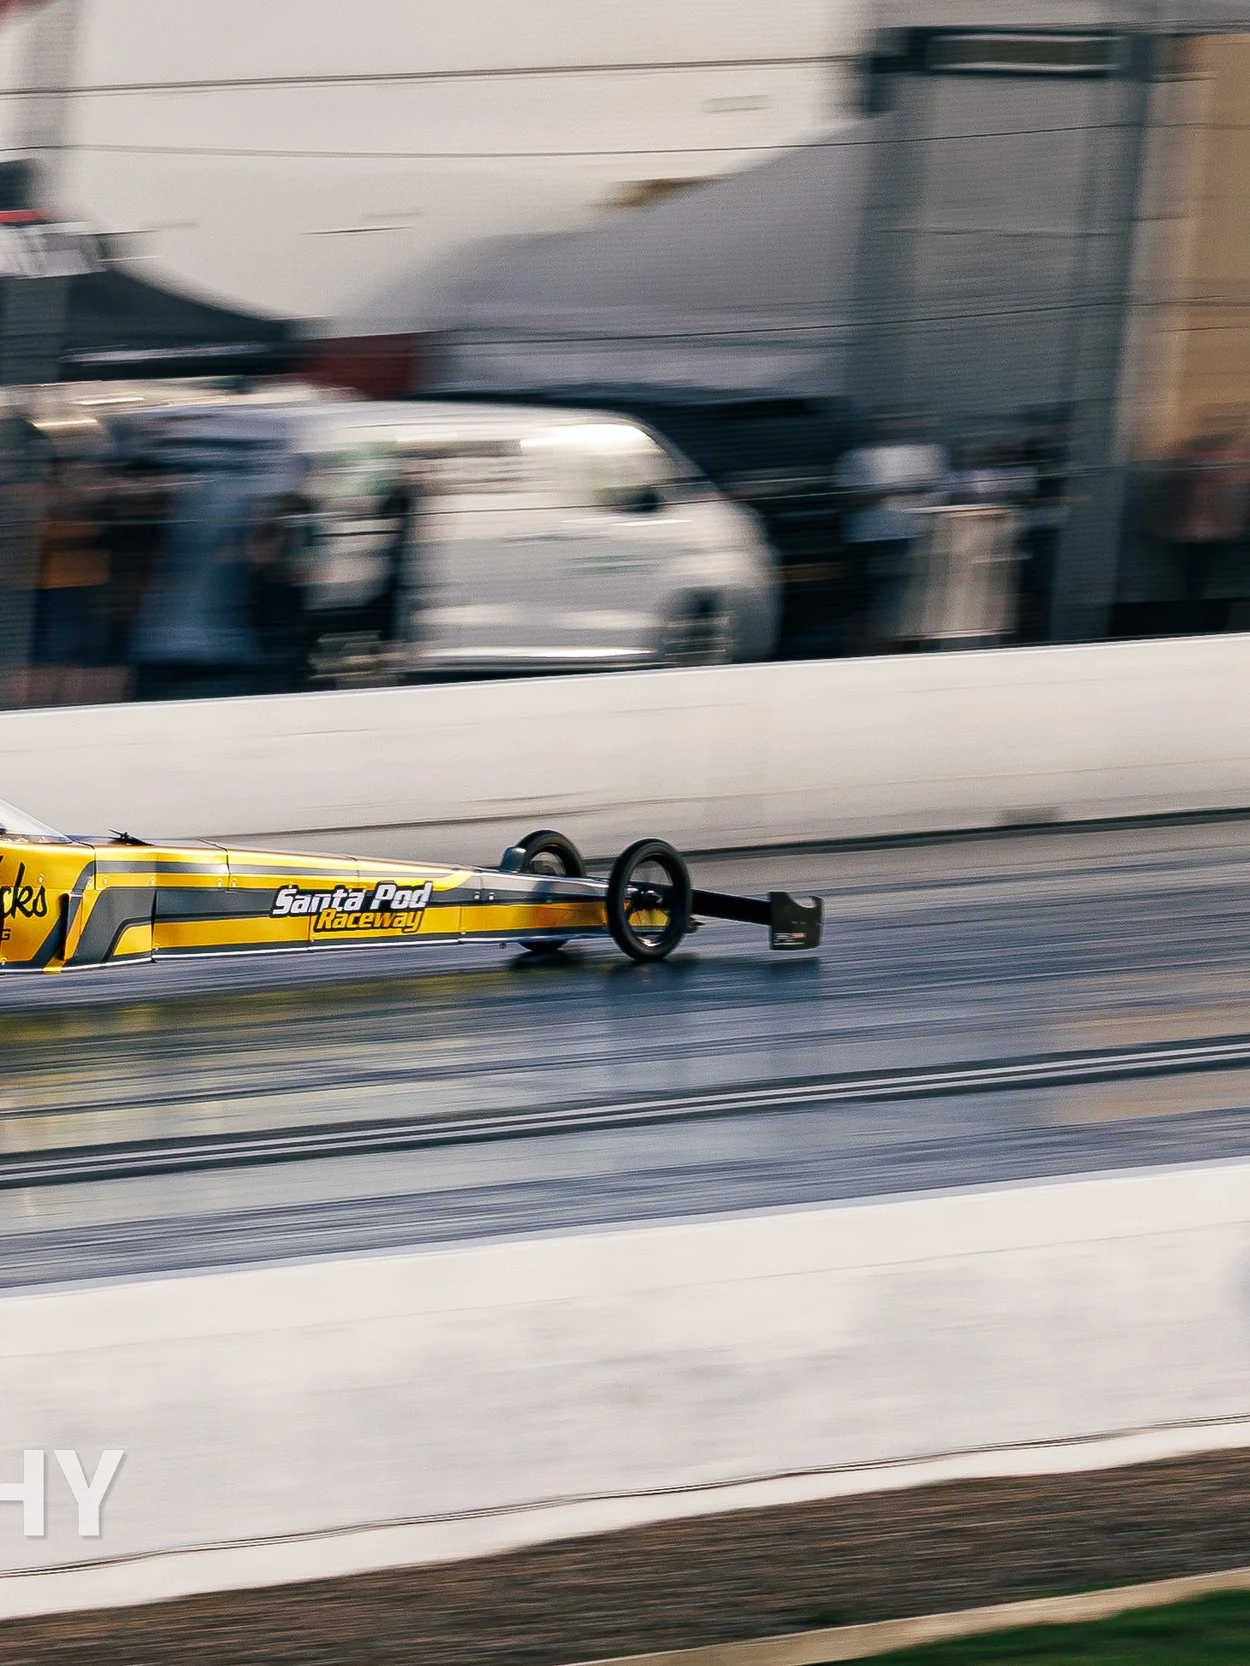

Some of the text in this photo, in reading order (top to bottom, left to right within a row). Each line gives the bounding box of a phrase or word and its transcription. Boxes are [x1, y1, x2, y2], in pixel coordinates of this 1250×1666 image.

[272, 881, 433, 915] Santa Pod
[316, 908, 423, 932] Raceway
